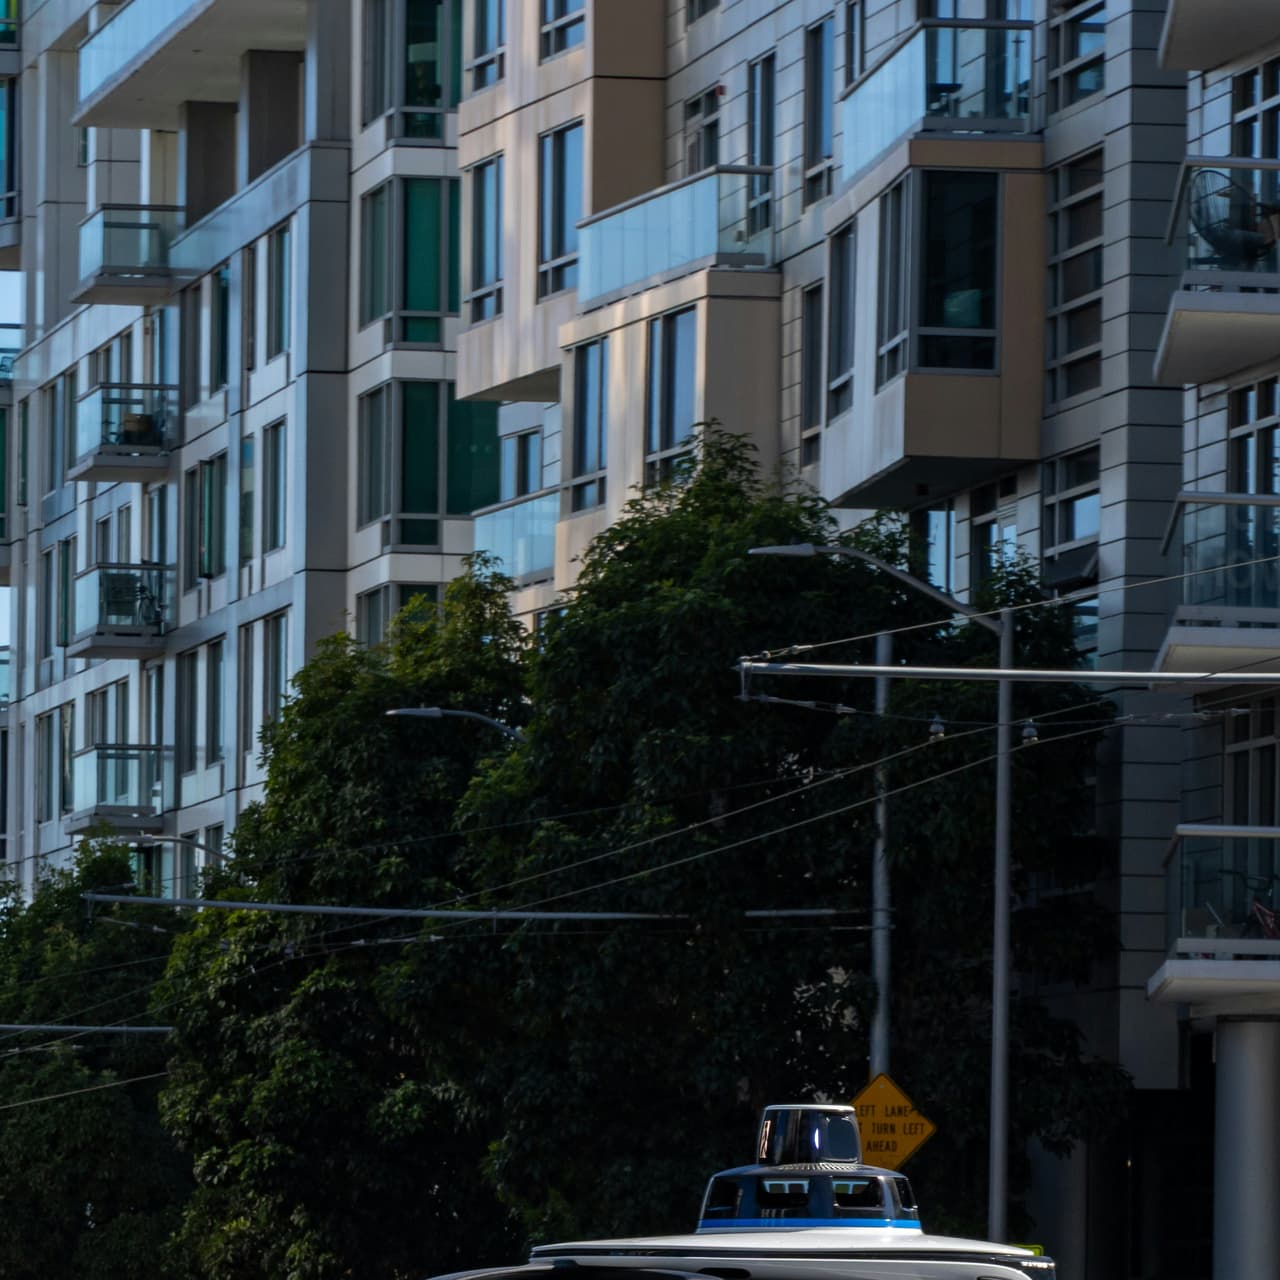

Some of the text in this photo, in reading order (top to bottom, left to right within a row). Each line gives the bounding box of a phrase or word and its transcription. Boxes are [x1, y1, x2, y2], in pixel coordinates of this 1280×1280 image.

[884, 1104, 910, 1118] LANE
[872, 1122, 896, 1135] TURN
[903, 1122, 925, 1136] LEFT
[866, 1141, 897, 1152] AHEAD
